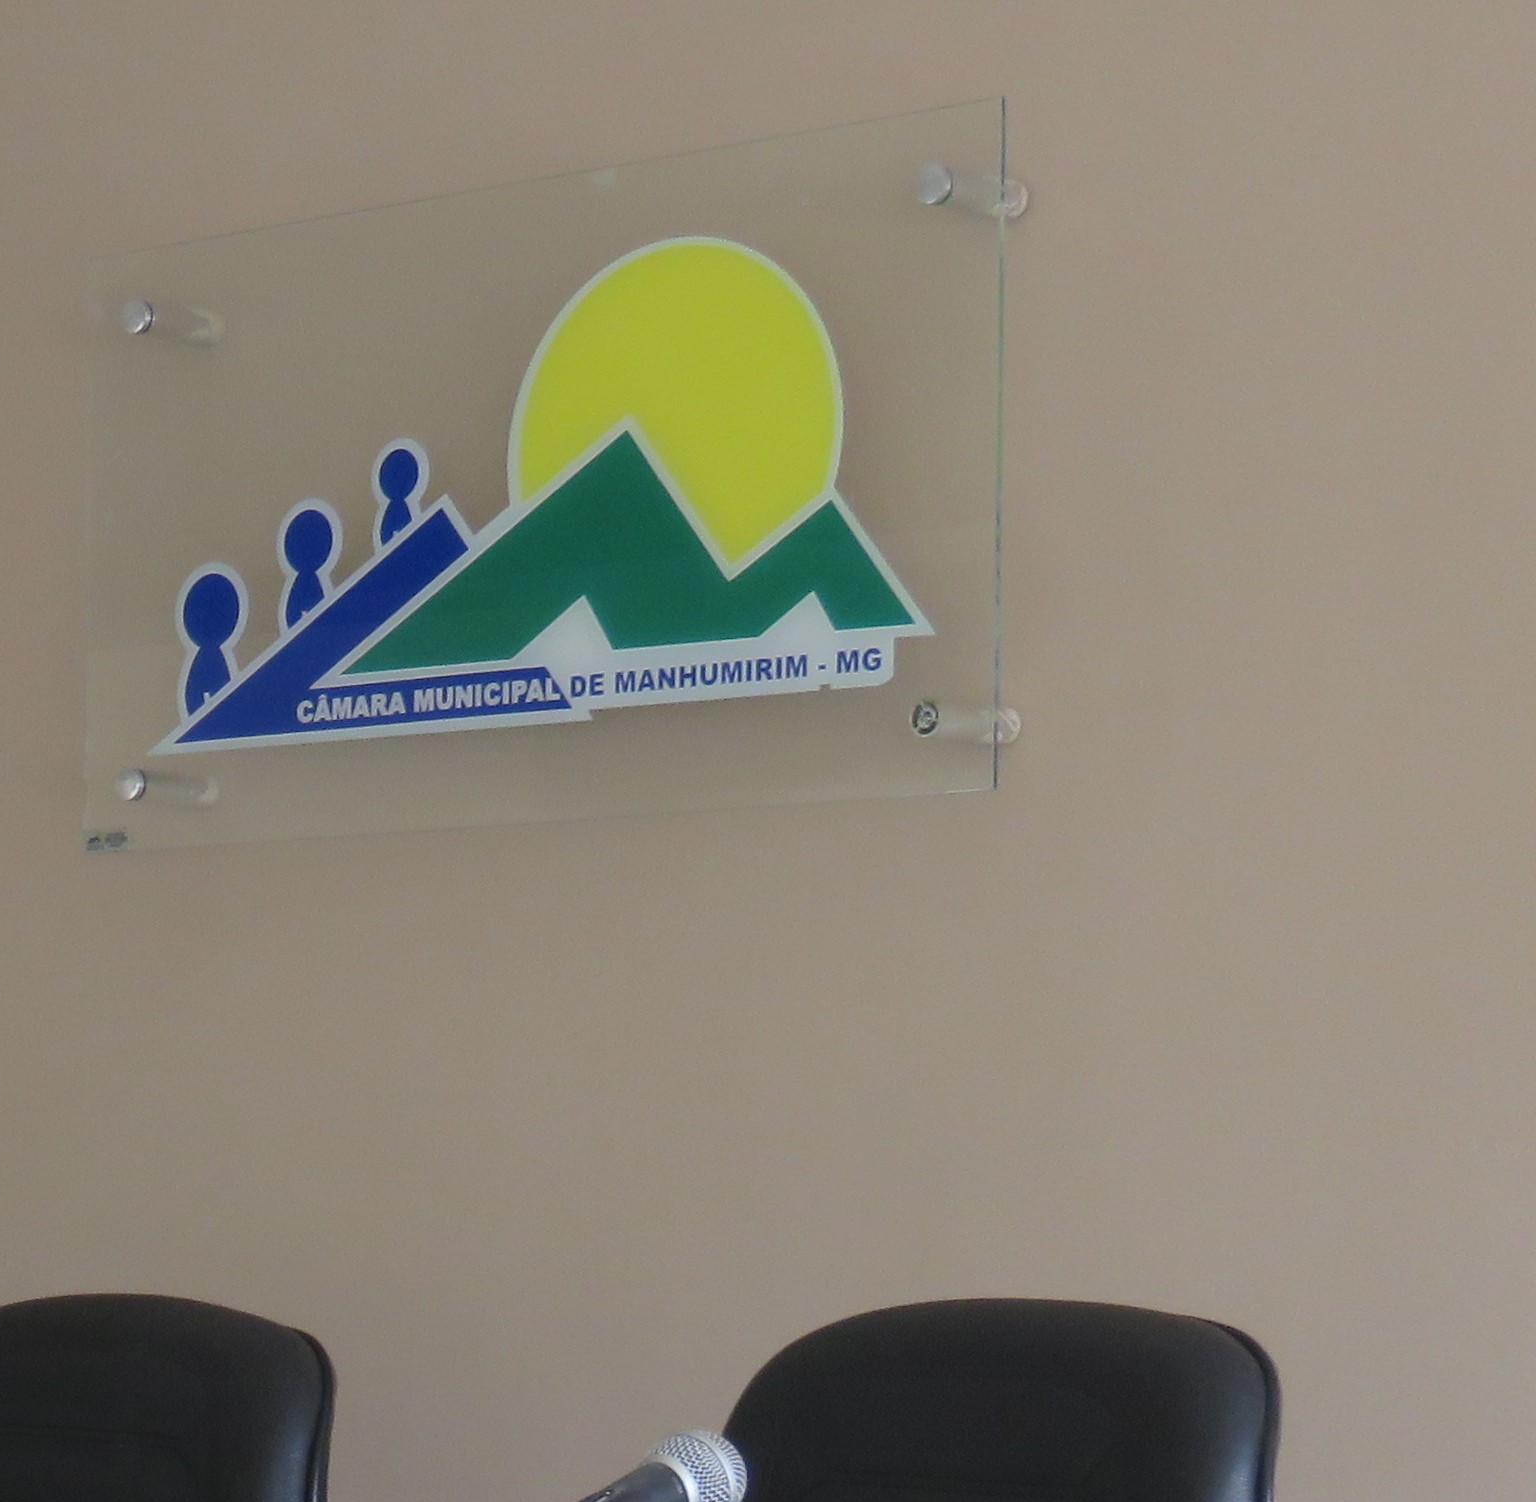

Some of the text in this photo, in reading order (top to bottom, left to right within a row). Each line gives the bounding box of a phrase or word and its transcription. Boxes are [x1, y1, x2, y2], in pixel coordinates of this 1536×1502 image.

[296, 693, 407, 724] CÂMARA
[413, 677, 562, 713] MUNICIPAL
[569, 672, 606, 699] DE
[614, 653, 809, 694] MANHUMIRIM
[835, 647, 883, 675] MG
